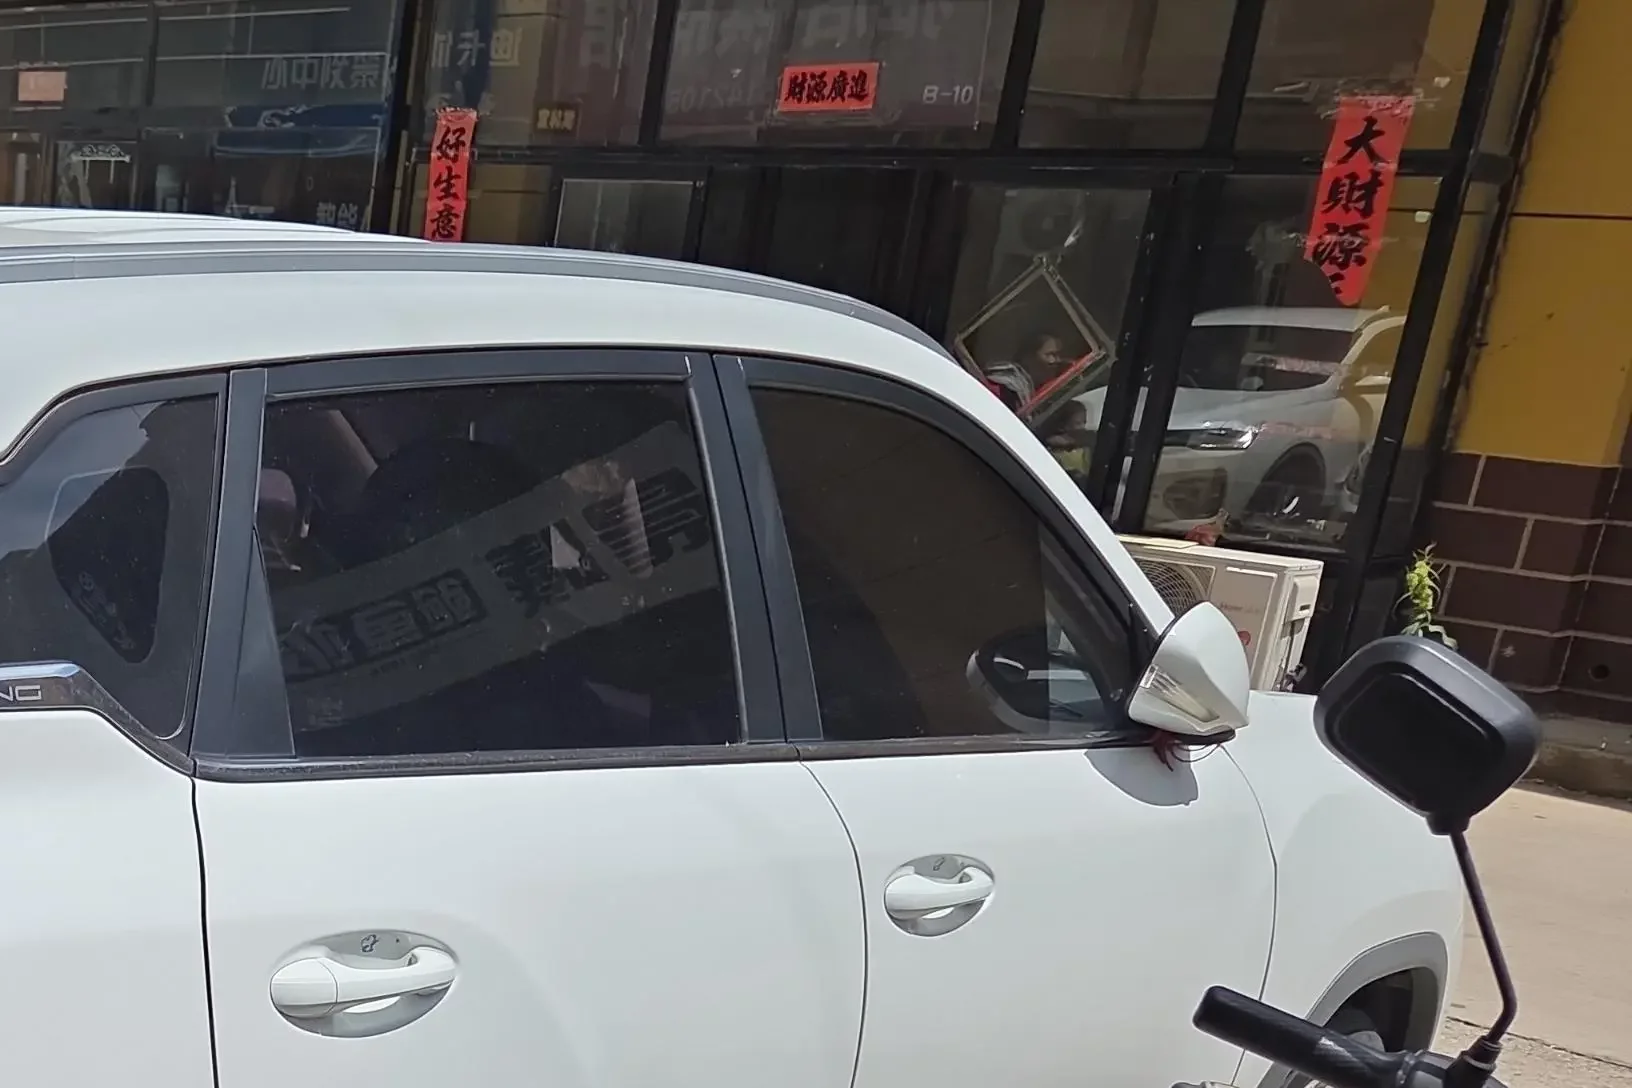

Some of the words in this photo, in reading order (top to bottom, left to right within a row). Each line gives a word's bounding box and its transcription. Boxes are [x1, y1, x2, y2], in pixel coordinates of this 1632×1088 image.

[784, 70, 869, 104] 財源廣進
[922, 85, 973, 105] B-10
[429, 126, 467, 239] 好生意
[1311, 115, 1390, 295] 大財源
